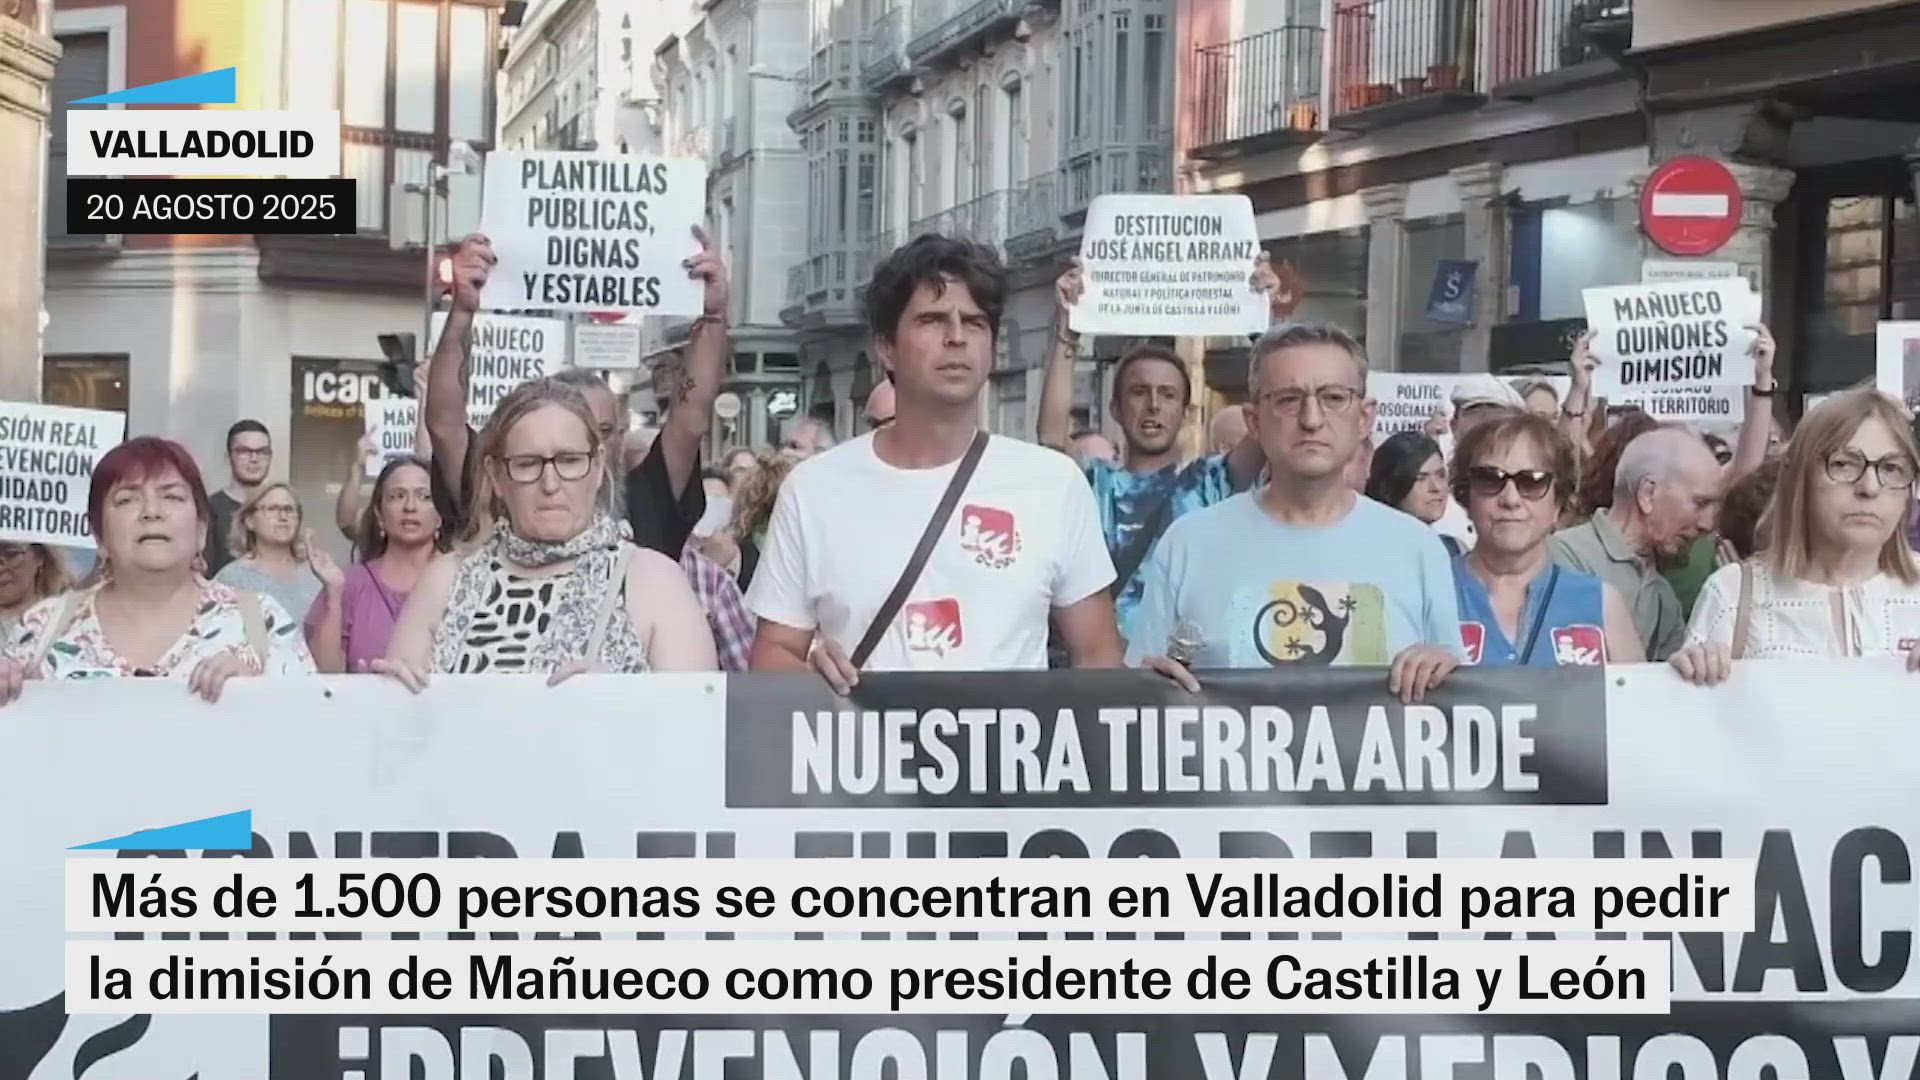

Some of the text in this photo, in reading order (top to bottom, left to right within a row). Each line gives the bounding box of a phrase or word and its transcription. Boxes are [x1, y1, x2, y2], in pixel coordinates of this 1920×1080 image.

[522, 159, 668, 195] PLANTILLAS
[528, 192, 655, 237] PÚBLICAS,
[547, 236, 639, 269] DIGNAS
[1086, 238, 1129, 260] JOSÉ
[1187, 241, 1253, 262] ARRANZ
[523, 271, 661, 307] Y ESTABLES
[1140, 271, 1178, 283] GENERAL
[1180, 271, 1190, 283] DE
[1192, 271, 1246, 283] PATRIMONIO
[1165, 305, 1206, 315] CASTILLA
[1614, 291, 1723, 321] MAÑUECO
[472, 321, 544, 352] AÑUECO
[1616, 320, 1728, 356] QUIÑONES
[1620, 351, 1723, 385] DIMISIÓN
[1651, 397, 1730, 415] TERRITORIO
[50, 420, 98, 449] REAL
[791, 703, 1540, 795] NUESTRA TIERRA ARDE
